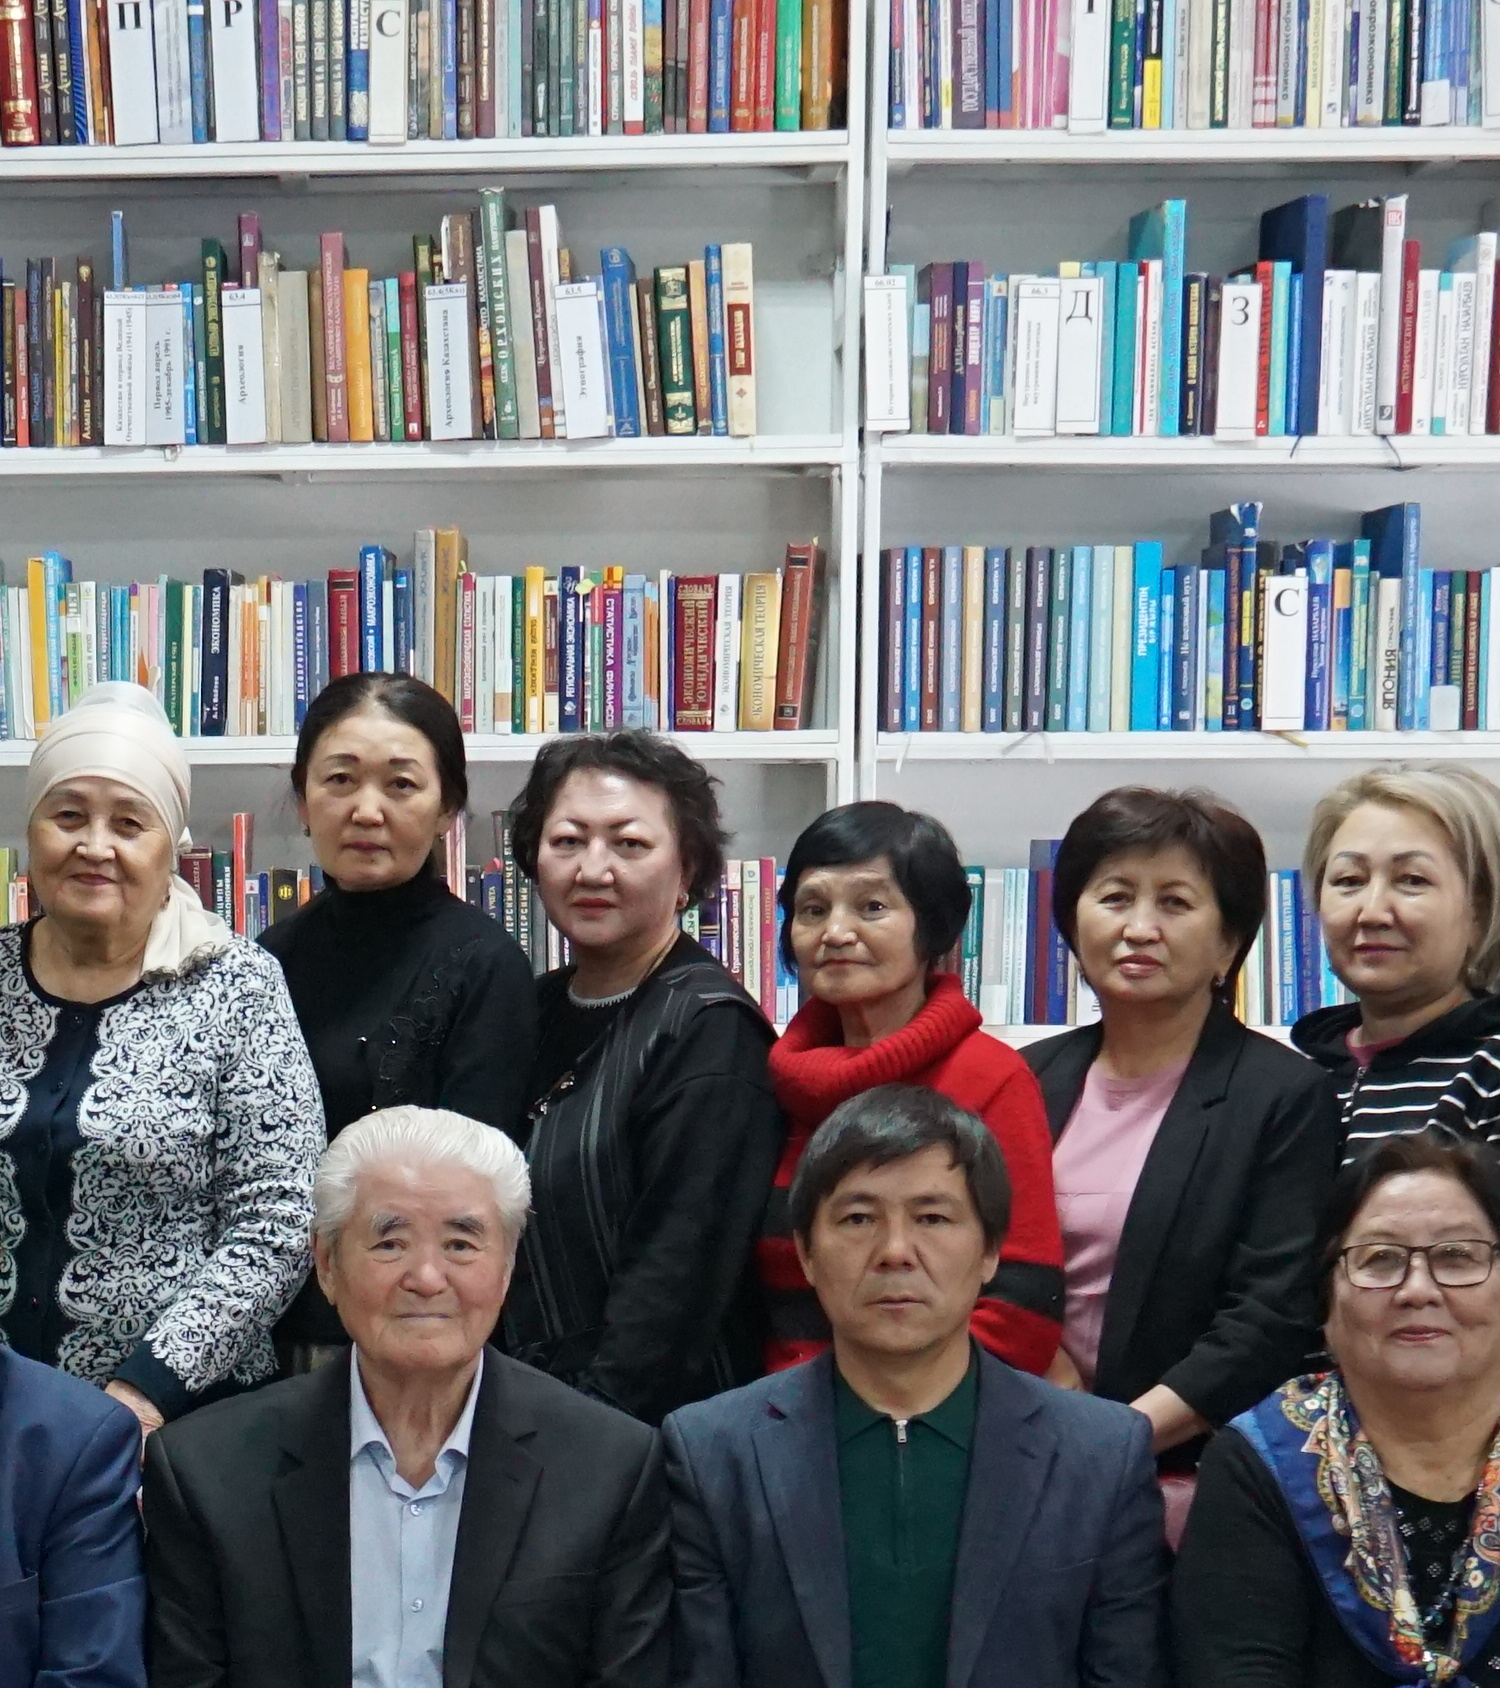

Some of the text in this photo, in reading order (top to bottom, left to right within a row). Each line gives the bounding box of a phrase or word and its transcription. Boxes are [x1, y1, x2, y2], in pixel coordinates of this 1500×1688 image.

[117, 2, 144, 31] П
[222, 0, 243, 28] Р
[376, 8, 402, 39] С
[475, 245, 487, 303] КАЗАХСТАНА
[1065, 290, 1093, 325] Д
[1150, 320, 1158, 350] АСТАНА
[1229, 295, 1250, 325] З
[1401, 280, 1416, 394] ИСТОРИЧЕСКИЙ ВЫБОР
[1458, 281, 1473, 389] НУРСУЛТАН НАЗАРБАЕВ
[152, 340, 163, 409] Период апрель
[235, 344, 248, 405] Археология
[439, 309, 453, 428] Археология Казахстана
[574, 335, 588, 399] Этнография
[1363, 324, 1375, 430] НУРСУЛТАН НАЗАРБАЕВ
[211, 586, 222, 654] ЭКОНОМИКА
[1275, 587, 1300, 618] С
[296, 600, 305, 701] ДЕЛОПРОИЗВОДСТВО
[529, 619, 538, 697] ОБЩИЙ МЕНЕДЖМЕНТ
[565, 597, 576, 697] РЕГИОНАЛЬНАЯ ЭКОНОМИКА
[605, 598, 615, 728] СТАТИСТИКА ФИНАНСОВ
[681, 600, 694, 703] ЭКОНОМИЧЕСКИЙ
[695, 600, 709, 703] ЮРИДИЧЕСКИЙ
[722, 586, 733, 695] ЭКОНОМИЧЕСКАЯ ТЕОРИЯ
[752, 585, 766, 719] ЭКОНОМИЧЕСКАЯ ТЕОРИЯ
[488, 886, 497, 909] УЧЕТА
[504, 859, 514, 887] УЧЕТ
[731, 891, 740, 973] Стратегический анализ
[746, 893, 755, 930] Экономика
